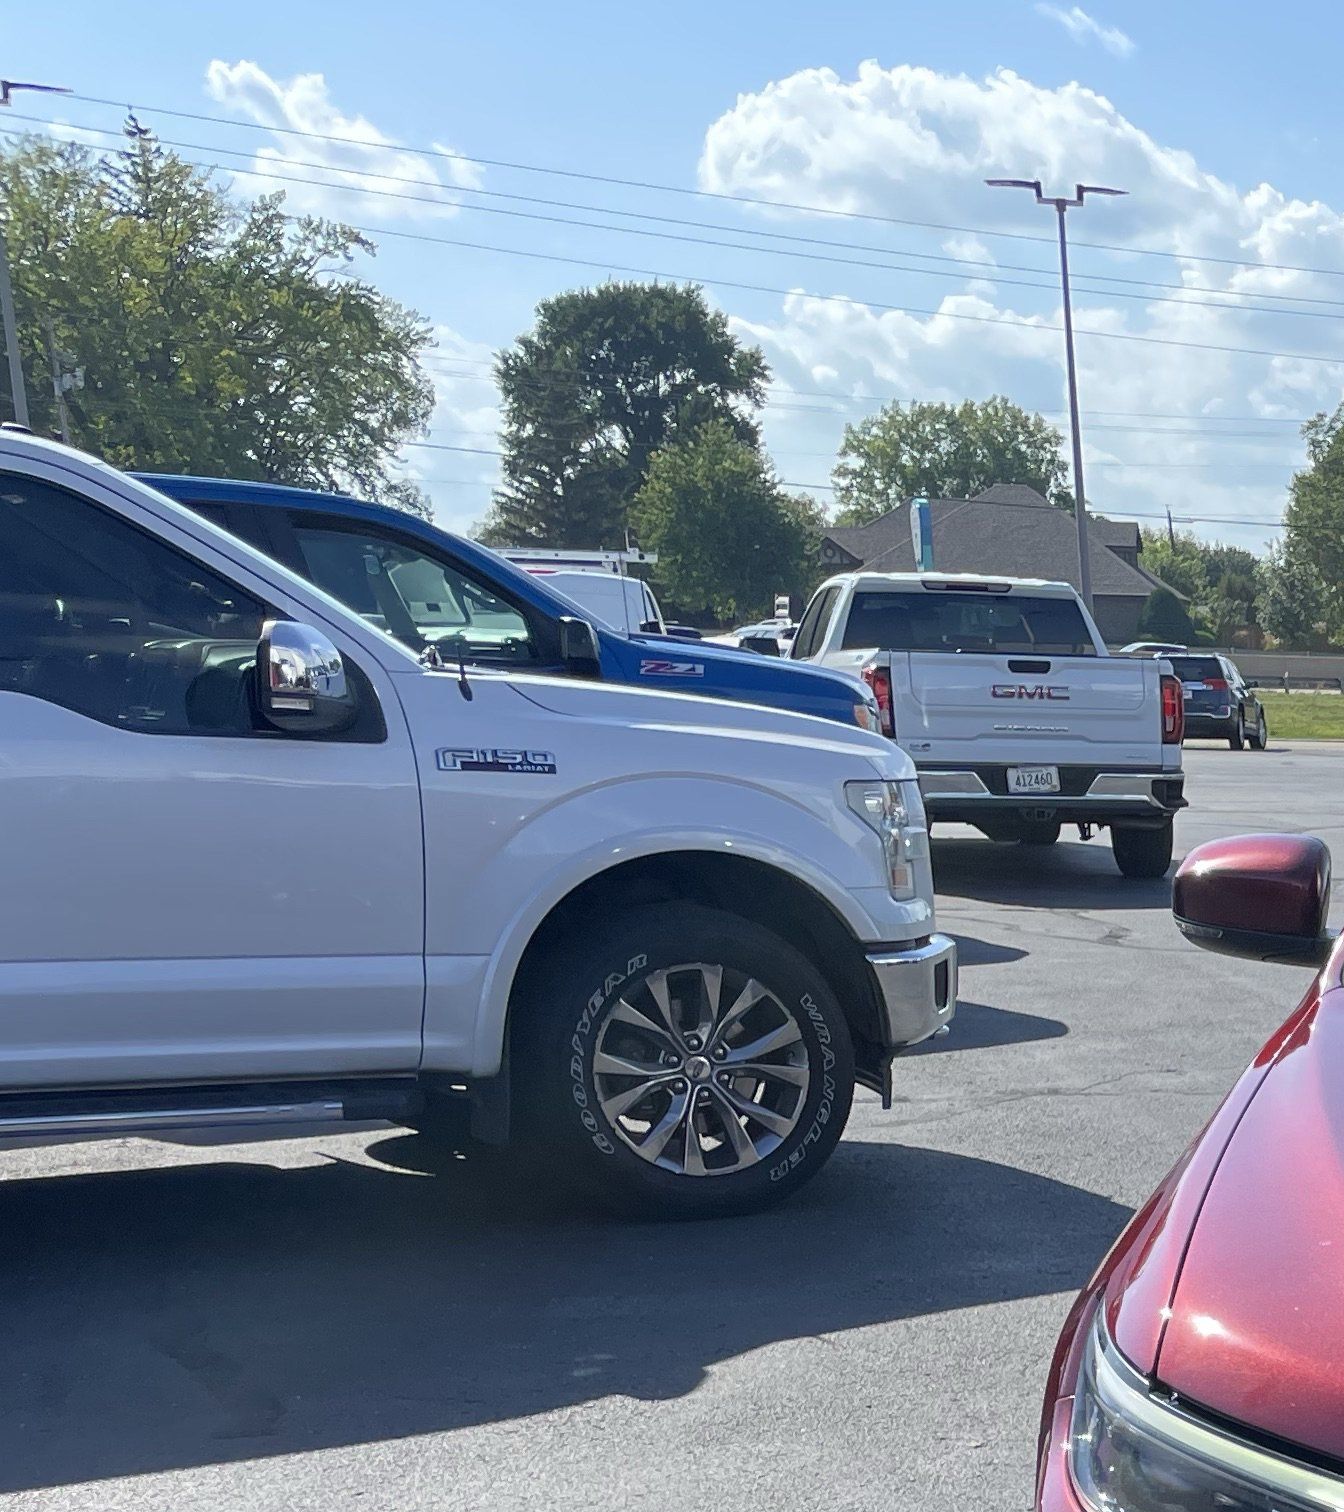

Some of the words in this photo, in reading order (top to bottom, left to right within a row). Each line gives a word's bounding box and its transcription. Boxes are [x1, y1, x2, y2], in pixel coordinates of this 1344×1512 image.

[991, 684, 1070, 700] GMC
[507, 763, 551, 773] LARIAT
[571, 953, 648, 1155] GOODYEAR
[770, 993, 836, 1181] WRANGLER
